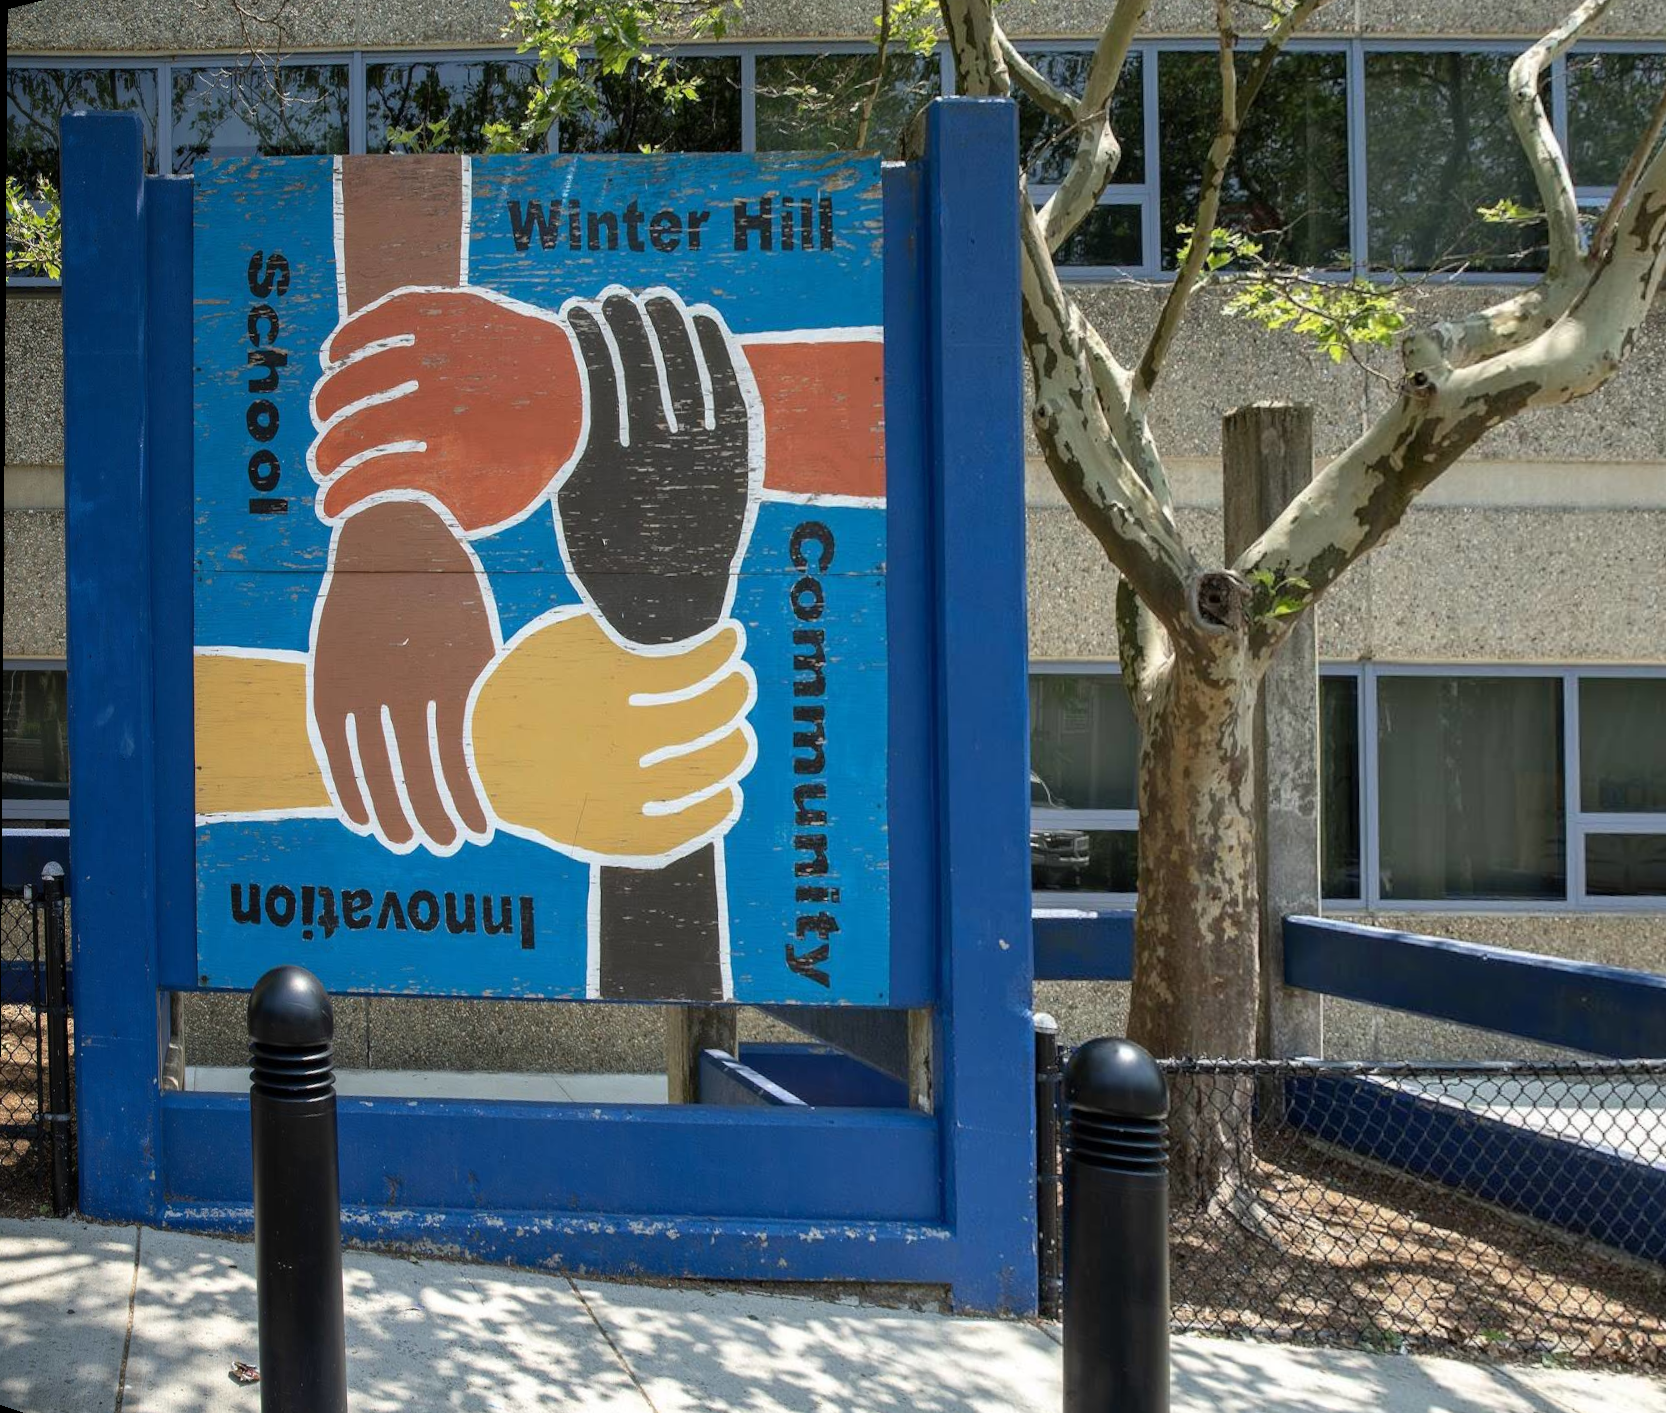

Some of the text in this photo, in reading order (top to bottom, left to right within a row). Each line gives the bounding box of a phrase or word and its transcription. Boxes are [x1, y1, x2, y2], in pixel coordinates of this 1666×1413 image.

[506, 197, 833, 252] Winter Hill
[247, 250, 290, 514] School
[786, 521, 839, 987] Community
[231, 884, 534, 949] Innovation
